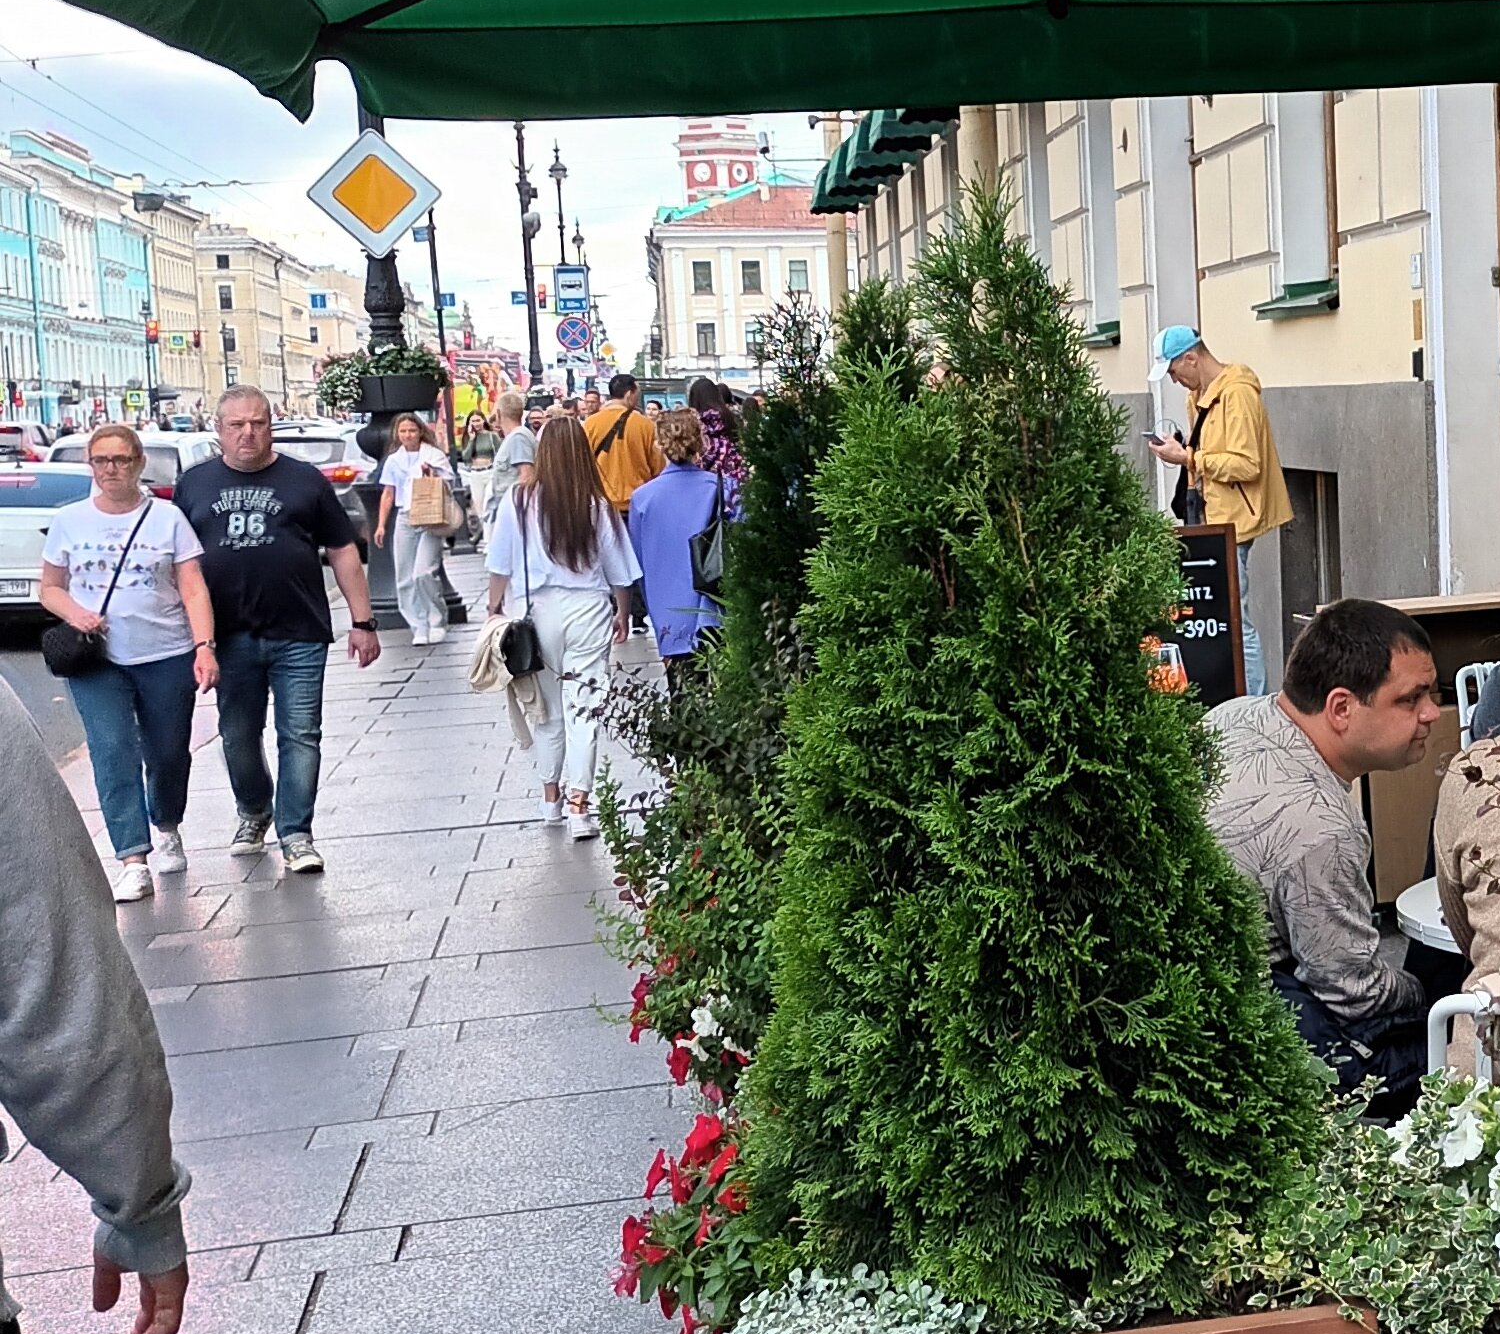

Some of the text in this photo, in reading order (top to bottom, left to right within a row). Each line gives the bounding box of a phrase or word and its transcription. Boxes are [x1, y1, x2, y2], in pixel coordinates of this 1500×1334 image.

[219, 489, 274, 502] HERITAGE
[242, 499, 282, 516] SPORTS
[227, 511, 267, 539] 86
